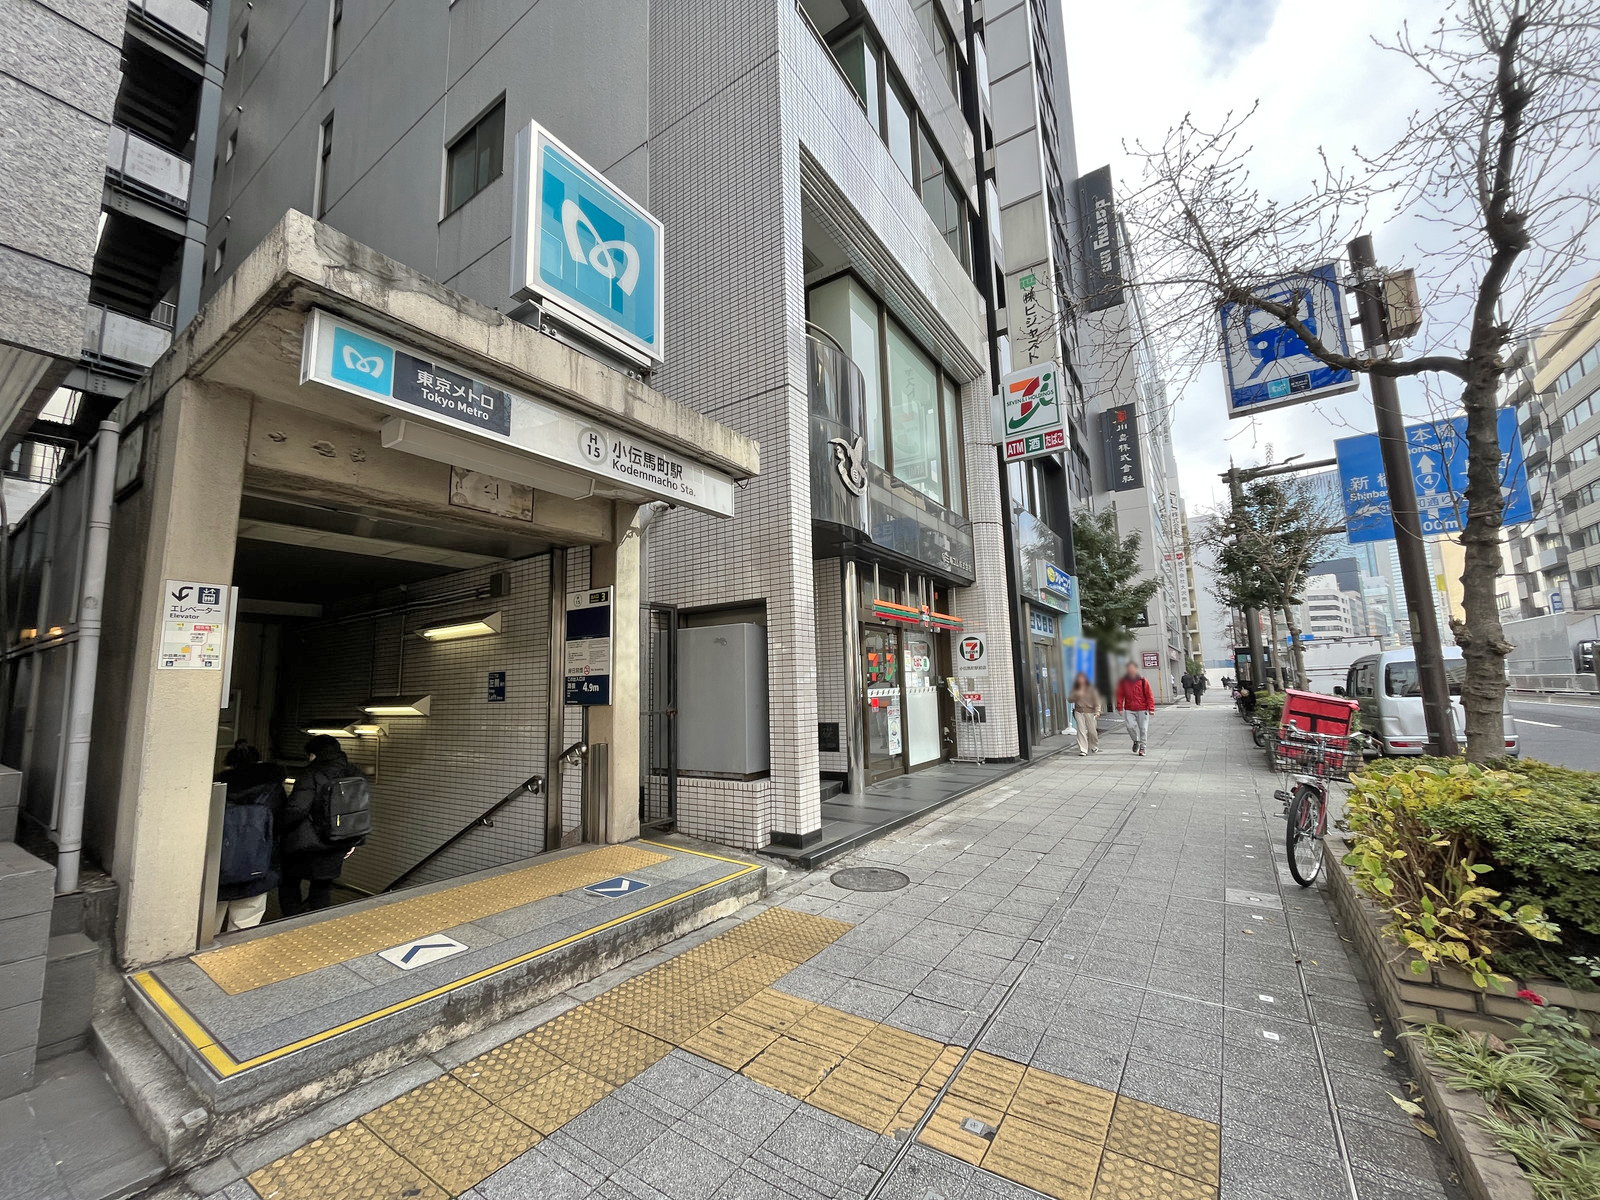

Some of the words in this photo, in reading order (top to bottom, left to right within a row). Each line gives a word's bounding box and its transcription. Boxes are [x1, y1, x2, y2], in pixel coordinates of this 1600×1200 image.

[417, 369, 493, 410] 東京メトロ
[421, 388, 455, 409] Tokyo
[458, 401, 489, 421] Metro
[1006, 397, 1022, 407] SEVEN
[1028, 390, 1055, 401] HOLDINGS
[589, 433, 598, 445] H
[1046, 432, 1064, 447] たばこ
[1404, 424, 1456, 444] 本橋
[587, 444, 601, 458] 15
[1007, 442, 1024, 456] ATM
[1029, 437, 1041, 451] 酒
[612, 441, 682, 480] 小伝馬町駅
[612, 459, 678, 490] Kodemmacho
[680, 483, 696, 497] Sta.
[1424, 475, 1434, 485] 4
[1423, 520, 1458, 532] 00m
[602, 592, 606, 601] 3
[170, 605, 221, 614] エレベーター
[582, 682, 600, 692] 4.9m
